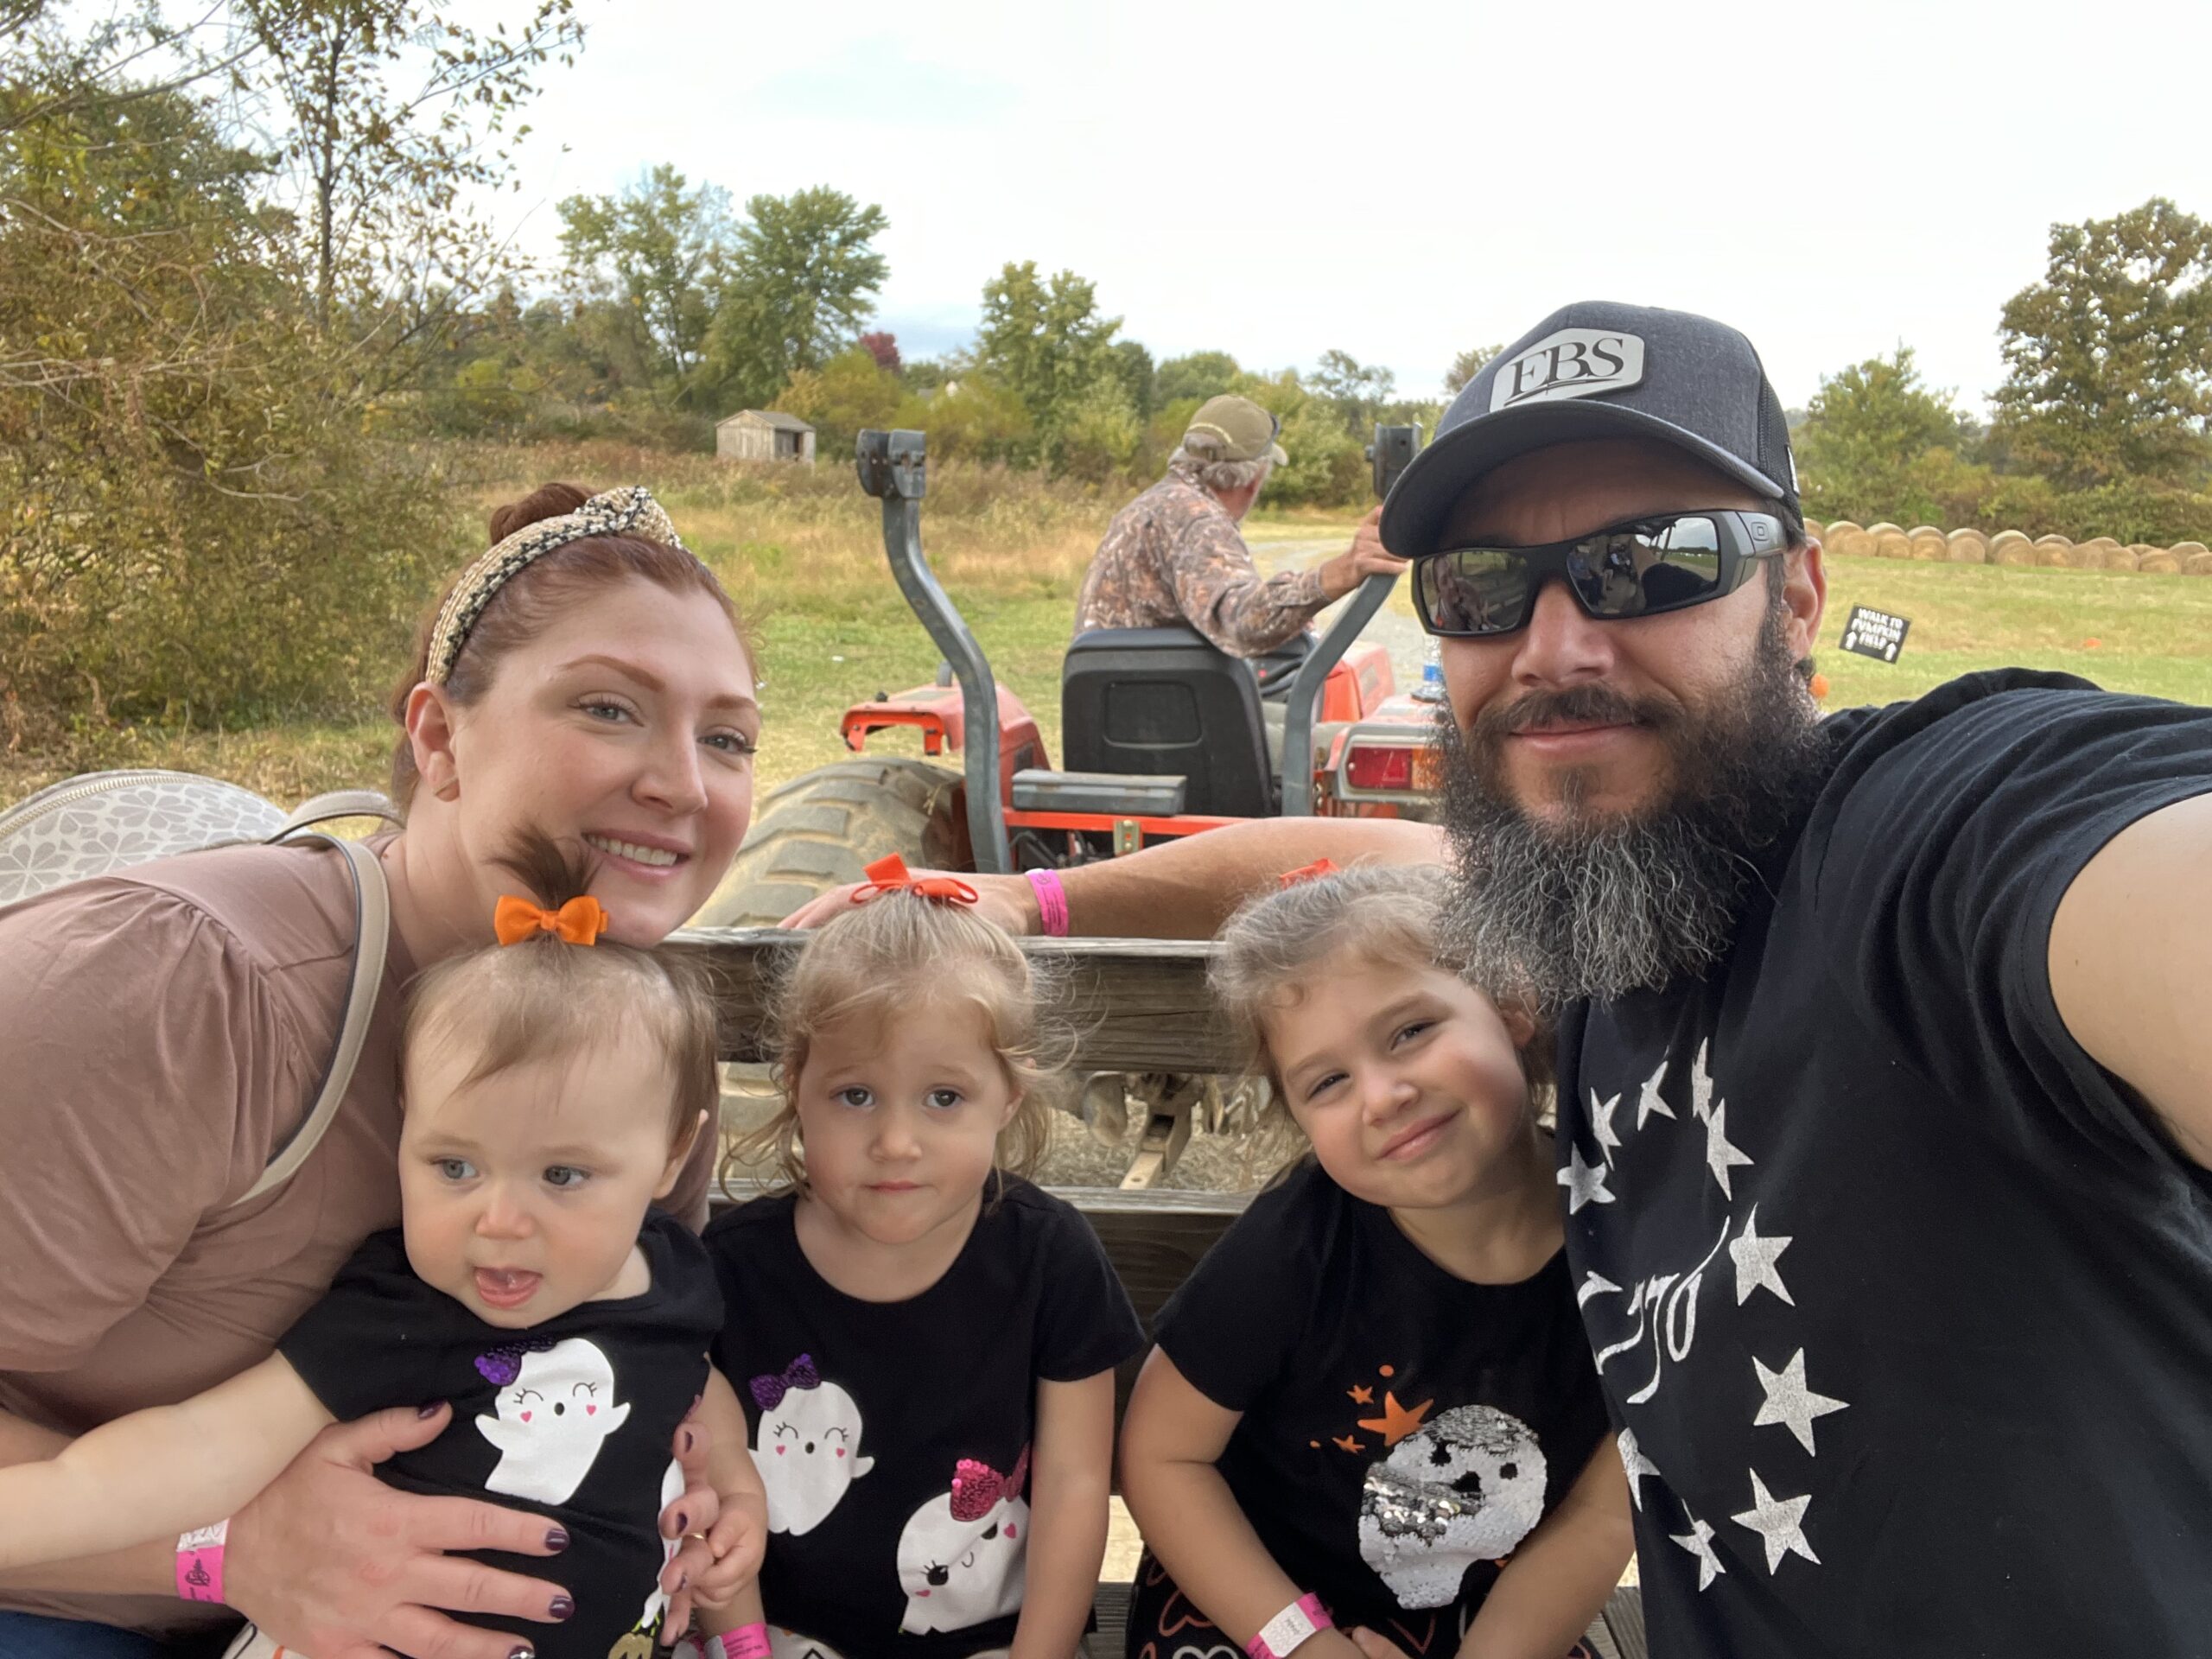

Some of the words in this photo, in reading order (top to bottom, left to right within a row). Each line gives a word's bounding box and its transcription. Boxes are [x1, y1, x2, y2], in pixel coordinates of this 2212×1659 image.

[1509, 337, 1624, 400] EBS
[1851, 618, 1902, 643] PUMPKIN
[1858, 607, 1889, 626] WALK
[1889, 617, 1904, 630] TO
[1859, 632, 1887, 650] FIELD
